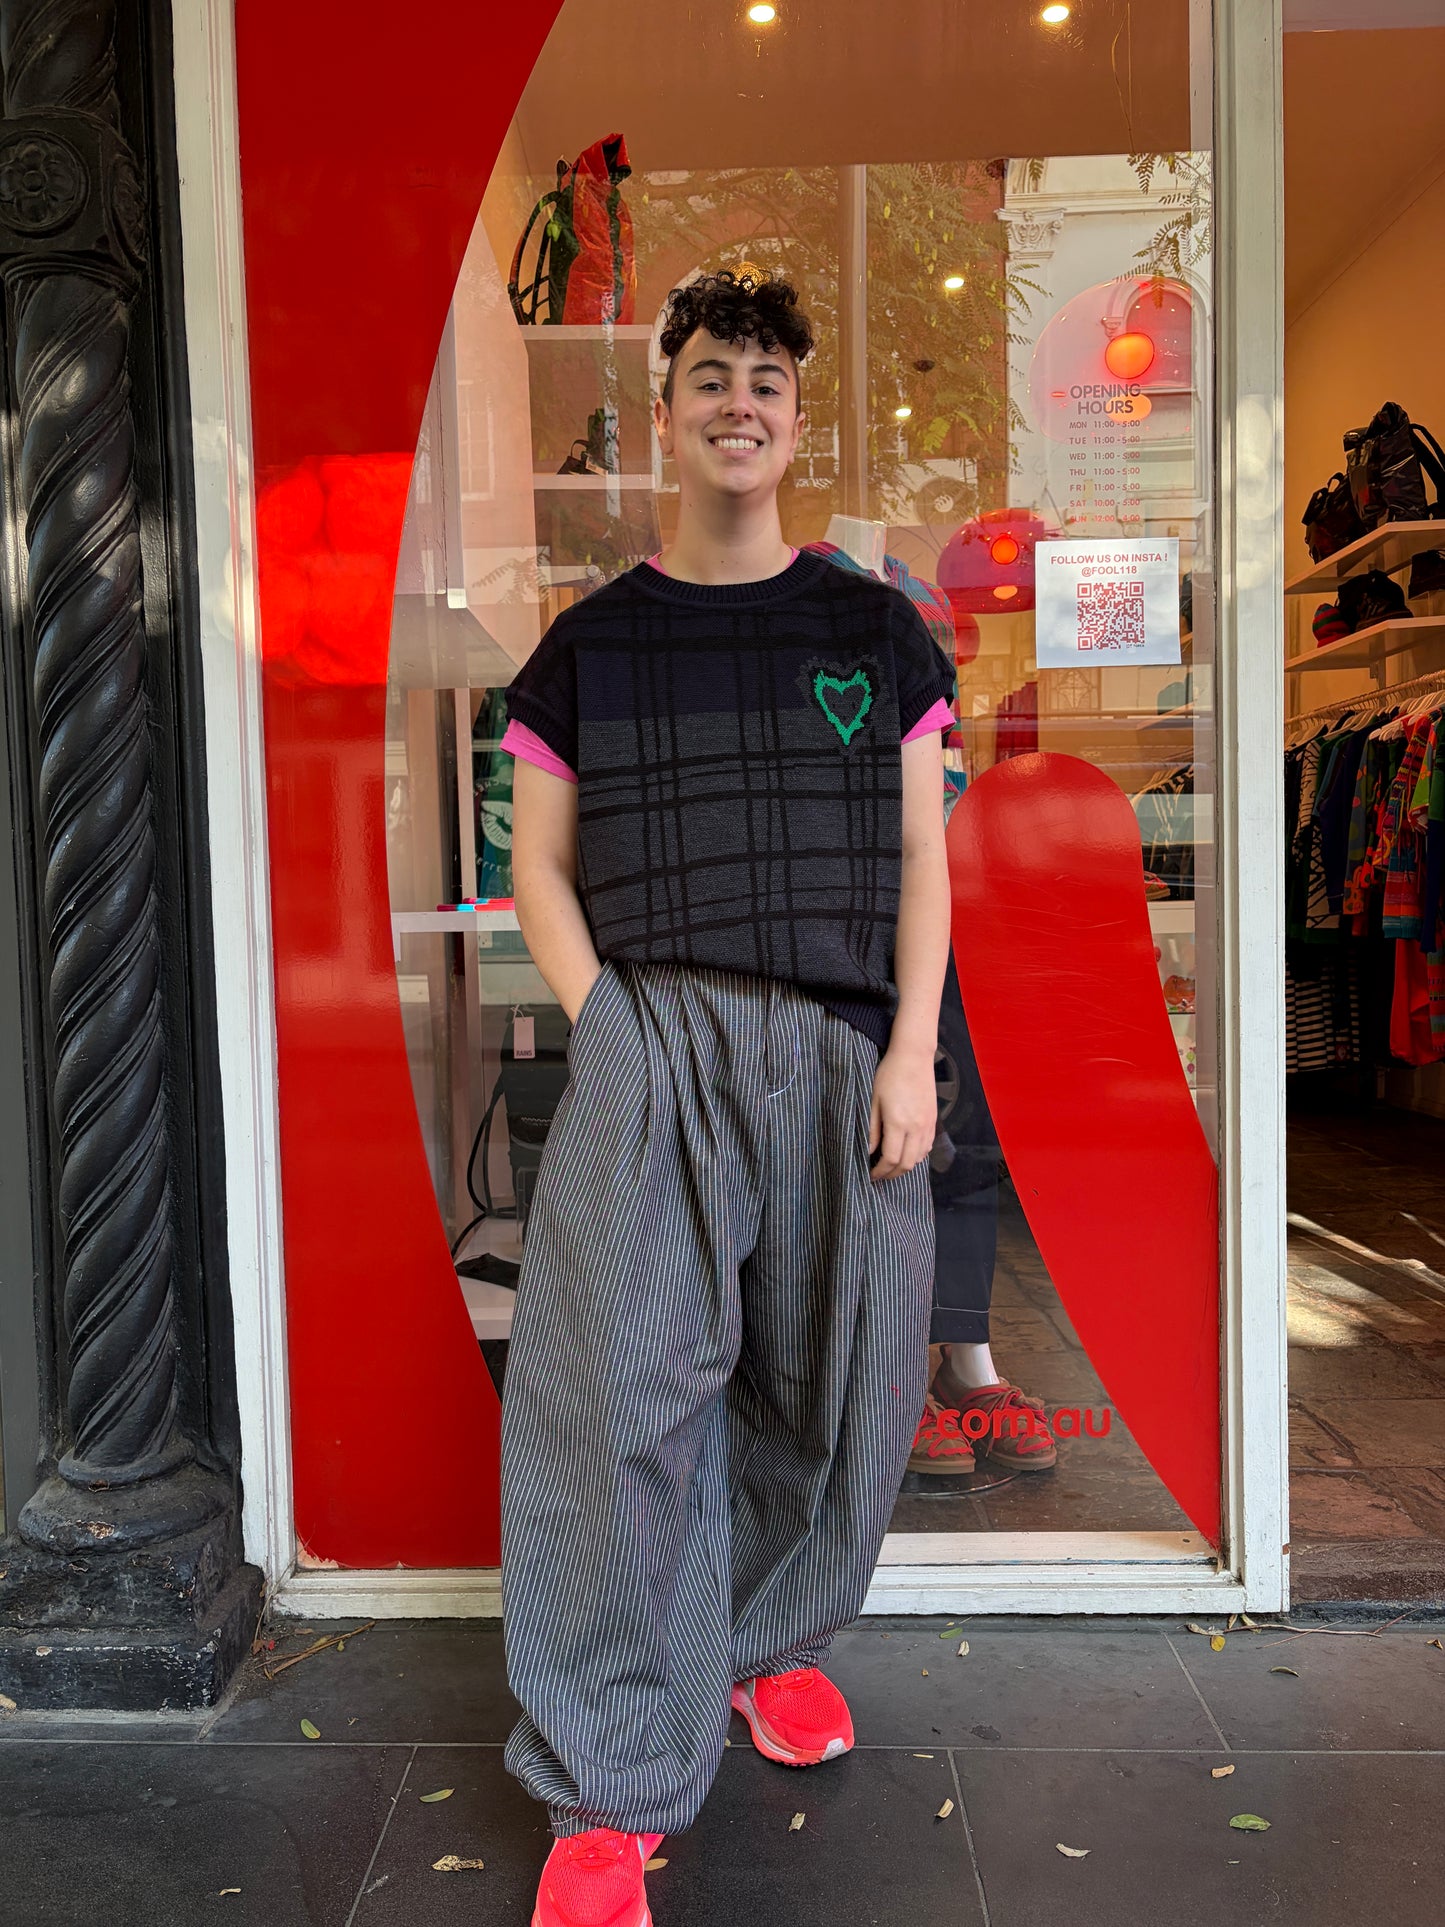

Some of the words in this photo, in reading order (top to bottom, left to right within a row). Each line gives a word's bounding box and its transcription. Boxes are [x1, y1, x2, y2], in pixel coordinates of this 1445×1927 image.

[1070, 383, 1141, 399] OPENING
[1077, 399, 1134, 415] HOURS
[1069, 421, 1087, 429] MON
[1093, 420, 1115, 428] 11:00
[1122, 419, 1141, 428] 5:00
[1069, 437, 1087, 445] TUE
[1093, 436, 1115, 444] 11:00
[1122, 435, 1141, 444] 5:00
[1069, 452, 1087, 461] WED
[1093, 452, 1115, 460] 11:00
[1122, 451, 1141, 460] 5:00
[1069, 468, 1087, 476] THU
[1093, 467, 1115, 475] 11:00
[1122, 467, 1141, 475] 5:00
[1069, 484, 1087, 492] FRI
[1093, 483, 1115, 491] 11:00
[1122, 482, 1141, 491] 5:00
[1069, 500, 1087, 508] SAT
[1093, 499, 1115, 507] 10:00
[1122, 498, 1141, 506] 5:00
[1050, 555, 1095, 565] FOLLOW
[1097, 554, 1111, 563] US
[1113, 553, 1129, 562] ON
[1131, 552, 1162, 562] INSTA
[1081, 566, 1138, 577] @FOOL118
